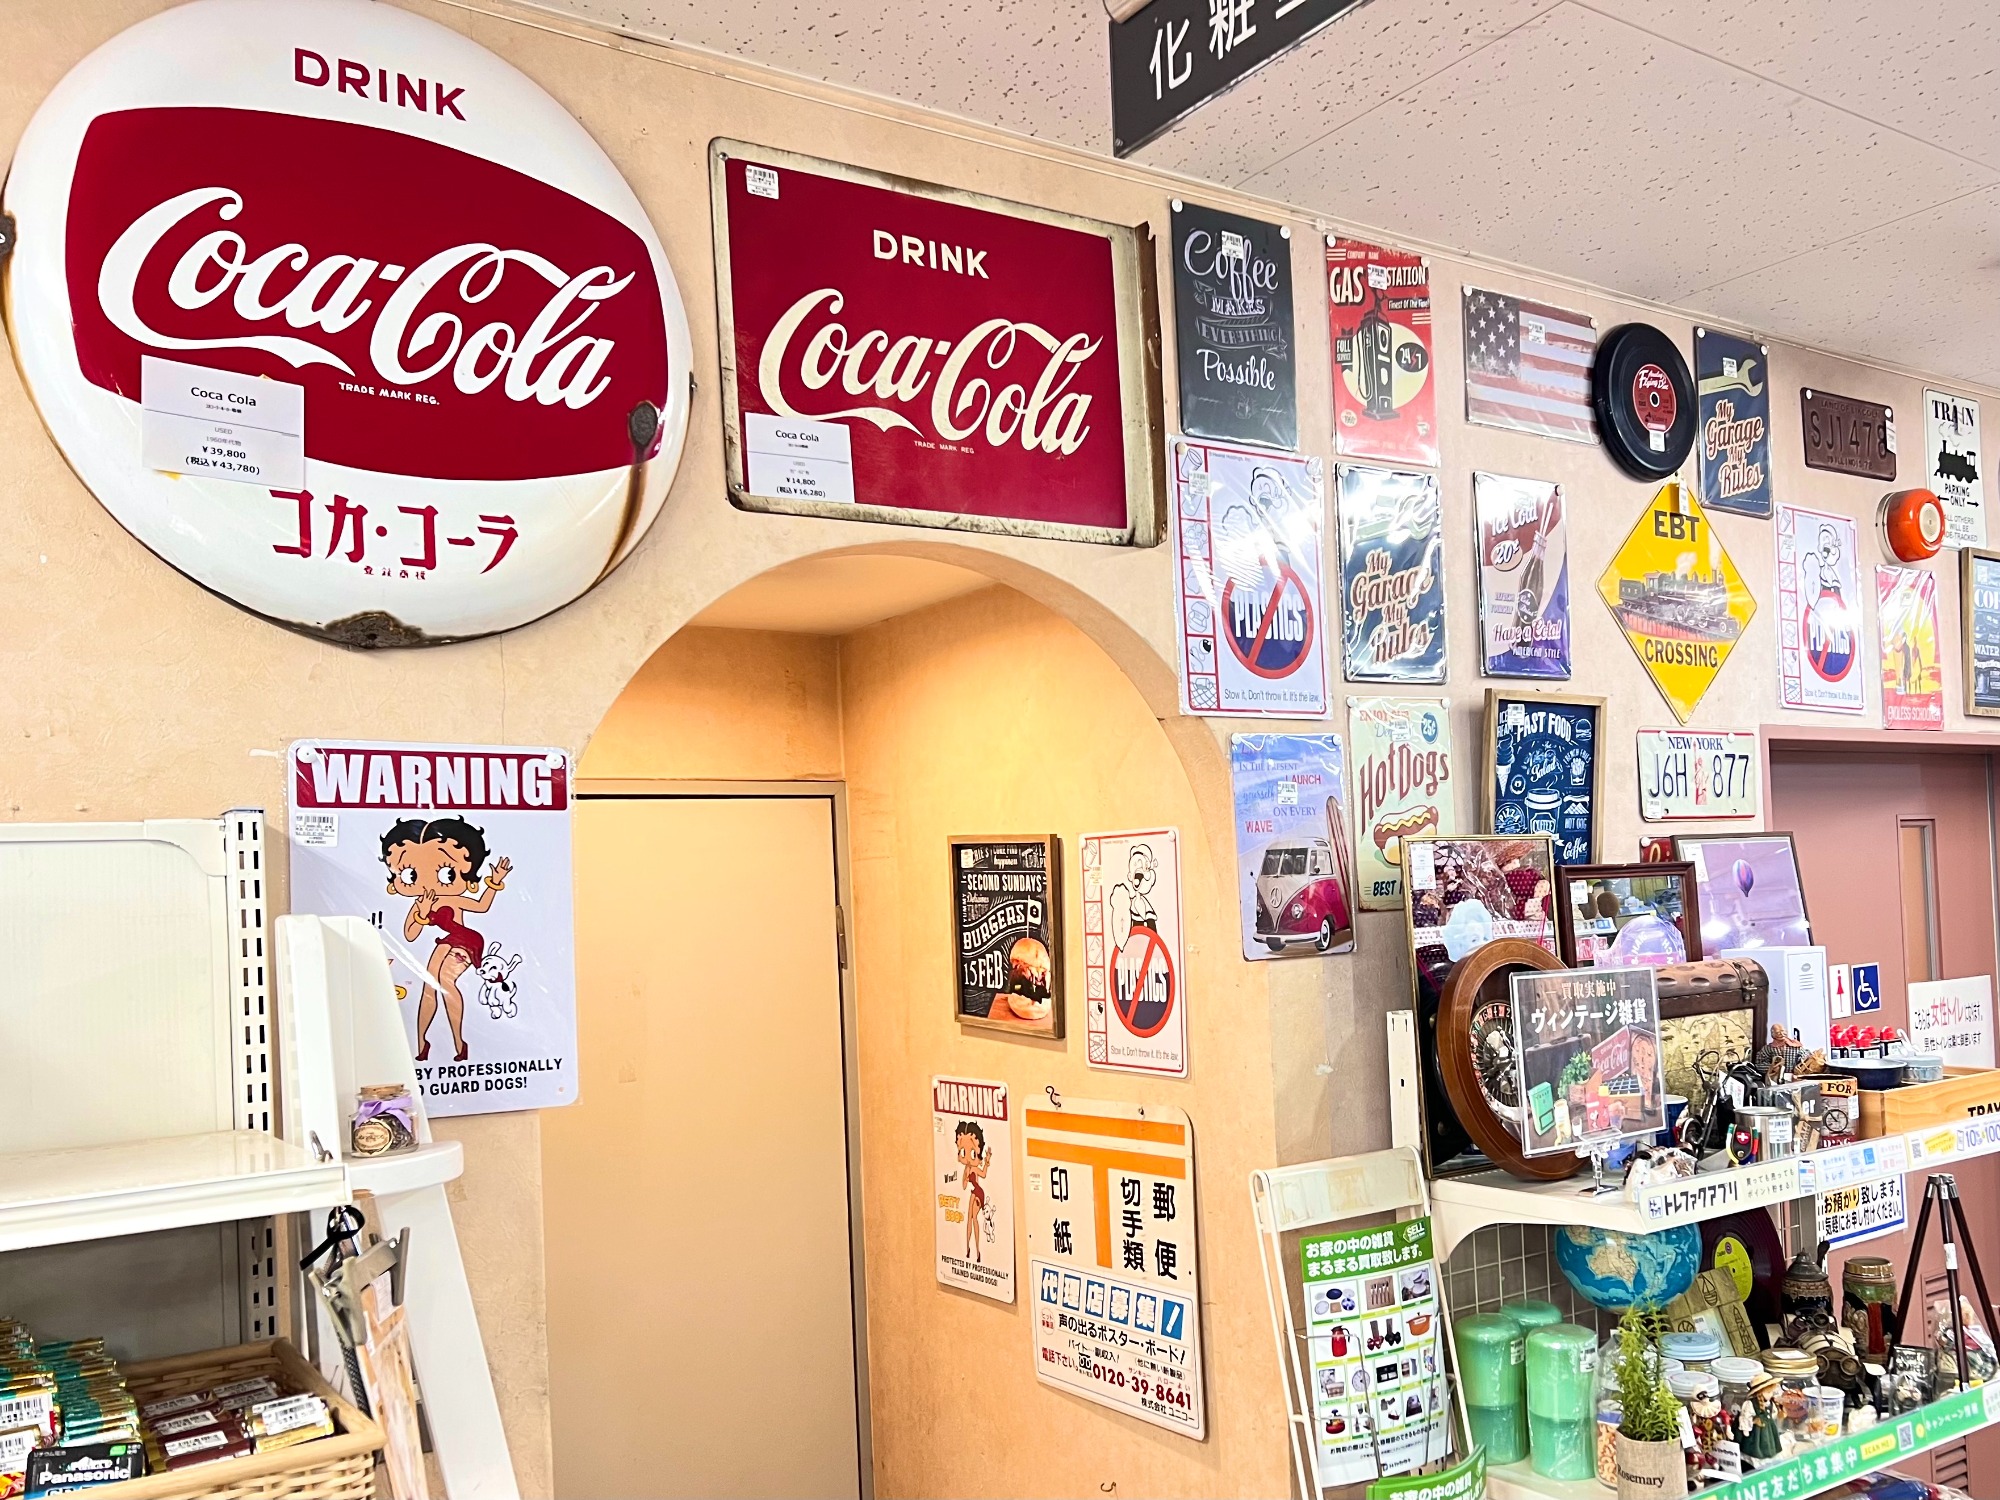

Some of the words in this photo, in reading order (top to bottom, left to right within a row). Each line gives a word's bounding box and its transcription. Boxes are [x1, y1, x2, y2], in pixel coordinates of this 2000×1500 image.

[294, 47, 467, 121] DRINK
[873, 229, 990, 280] DRINK
[1184, 230, 1279, 303] Coffee
[1329, 266, 1364, 304] GAS
[1386, 265, 1426, 286] STATION
[98, 186, 636, 409] Coca-Cola
[1211, 297, 1265, 317] MAKES
[1201, 323, 1278, 344] EVERYTHING
[1336, 339, 1351, 353] FULL
[1400, 347, 1411, 365] 24
[759, 288, 1103, 456] Coca-Cola
[1196, 348, 1276, 391] Possible
[190, 387, 223, 401] Coca
[228, 393, 257, 407] Cola
[338, 381, 376, 397] TRADE
[378, 388, 413, 402] MARK
[416, 391, 441, 406] REG.
[1715, 400, 1733, 420] My
[1931, 399, 1975, 427] TRAIN
[775, 429, 797, 440] Coca
[800, 432, 819, 442] Cola
[914, 440, 936, 451] TRADE
[939, 443, 958, 453] MARK
[1707, 418, 1763, 458] Garage
[1728, 446, 1745, 463] My
[1720, 464, 1763, 497] Rules
[1944, 483, 1970, 498] PARKING
[1949, 496, 1966, 507] ONLY
[1491, 514, 1509, 537] Ice
[1510, 502, 1538, 529] Cold
[1653, 509, 1700, 543] EBT
[1949, 523, 1961, 533] WILL
[1962, 524, 1969, 533] BE
[1954, 515, 1975, 525] OTHERS
[269, 489, 519, 575] コカ・コーラ
[1367, 551, 1391, 575] My
[1383, 603, 1406, 626] My
[1492, 622, 1521, 643] Have
[1544, 648, 1561, 659] STYLE
[1644, 637, 1718, 668] CROSSING
[1224, 688, 1240, 700] Stow
[1265, 690, 1281, 702] throw
[1887, 705, 1911, 721] ENDLESS
[1517, 711, 1546, 743] FAST
[1548, 712, 1571, 743] FOOD
[1668, 736, 1692, 750] NEW
[1696, 737, 1724, 751] YORK
[311, 753, 553, 806] WARNING
[1649, 753, 1688, 798] J6H
[1713, 753, 1749, 798] 877
[1273, 806, 1287, 817] ON
[1290, 806, 1317, 817] EVERY
[1498, 807, 1519, 823] PIZZA
[1245, 820, 1273, 833] WAVE
[1564, 818, 1575, 830] HOT
[1563, 837, 1588, 860] Coffee
[967, 874, 1000, 891] SECOND
[1002, 874, 1042, 892] SUNDAYS
[1373, 880, 1395, 897] BEST
[962, 904, 1025, 950] BURGERS
[963, 961, 978, 987] 15
[978, 950, 1004, 990] FEB
[1561, 979, 1617, 1000] 買取実施中
[1531, 998, 1648, 1034] ヴィンテージ雑貨
[439, 1058, 563, 1079] PROFESSIONALLY
[430, 1079, 480, 1096] GUARD
[485, 1077, 528, 1092] DOGS!
[1827, 1082, 1852, 1094] FOR
[937, 1083, 1004, 1119] WARNING
[938, 1195, 960, 1210] BETTY
[1664, 1181, 1738, 1215] トレファクアプリ
[1824, 1180, 1900, 1214] お預かり致します。
[945, 1209, 965, 1224] BOOP
[1050, 1165, 1073, 1255] 印紙
[1120, 1177, 1146, 1272] 切手類
[1152, 1182, 1178, 1280] 郵便
[1306, 1231, 1395, 1259] お家の中の雑貨
[1406, 1222, 1425, 1238] SELL
[941, 1254, 965, 1268] PROTECTED
[965, 1261, 972, 1270] BY
[972, 1262, 1009, 1280] PROFESSIONALLY
[1307, 1244, 1423, 1278] まるまる買取致します。
[951, 1266, 970, 1278] TRAINED
[970, 1272, 984, 1283] GUARD
[1092, 1363, 1192, 1411] 0120-39-8641
[1141, 1397, 1167, 1415] 株式会社
[39, 1465, 131, 1486] Panasonic
[1617, 1463, 1666, 1488] Rosemary
